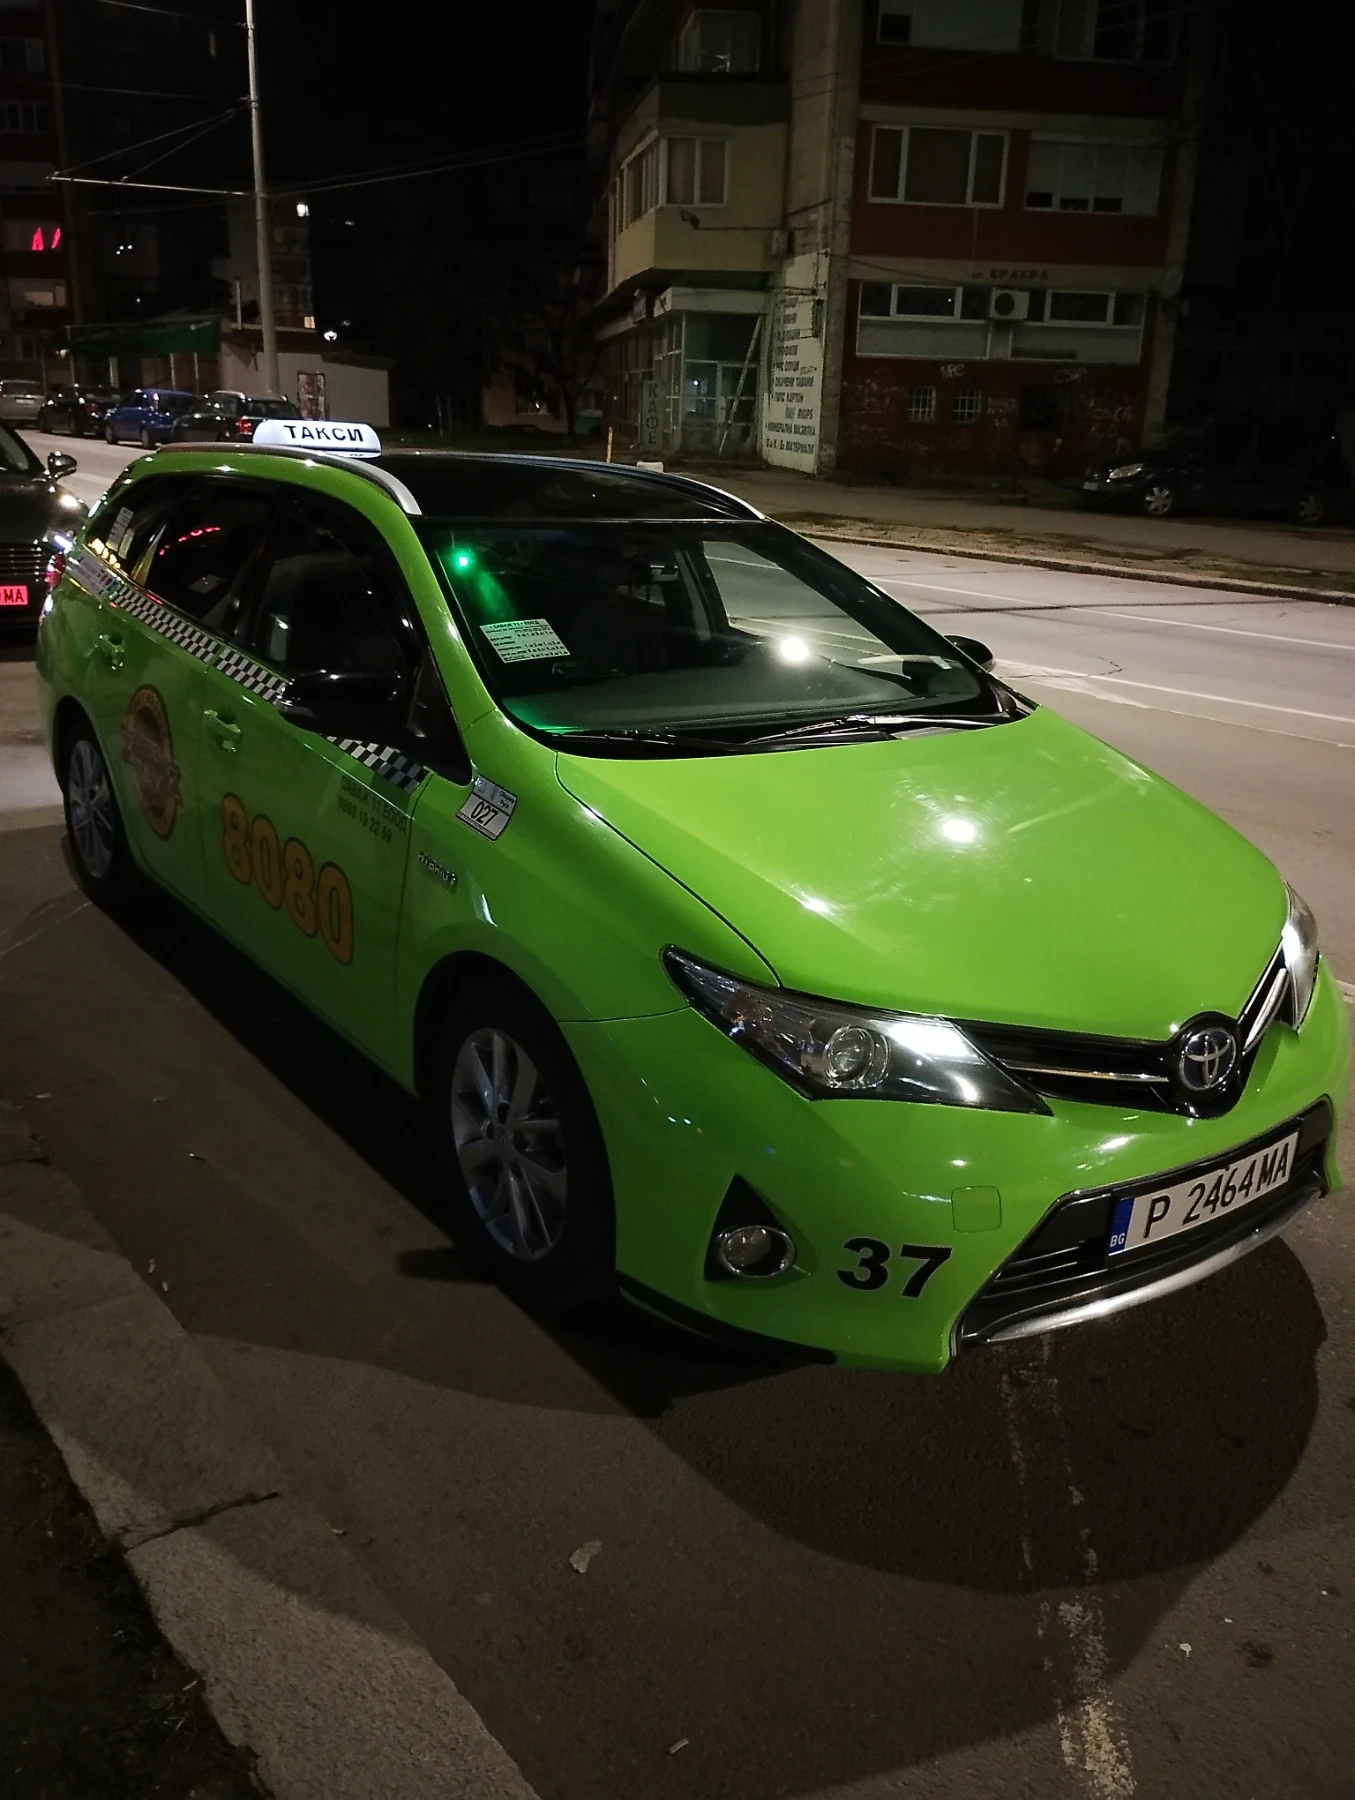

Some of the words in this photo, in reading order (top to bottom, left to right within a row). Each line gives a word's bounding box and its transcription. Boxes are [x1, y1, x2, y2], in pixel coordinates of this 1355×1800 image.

[283, 425, 364, 442] ТАКСИ
[646, 383, 660, 445] КАФЕ
[470, 800, 500, 827] 027
[221, 791, 355, 966] 8080
[1109, 1232, 1126, 1249] BG
[1142, 1194, 1172, 1240] P
[837, 1236, 953, 1298] 37
